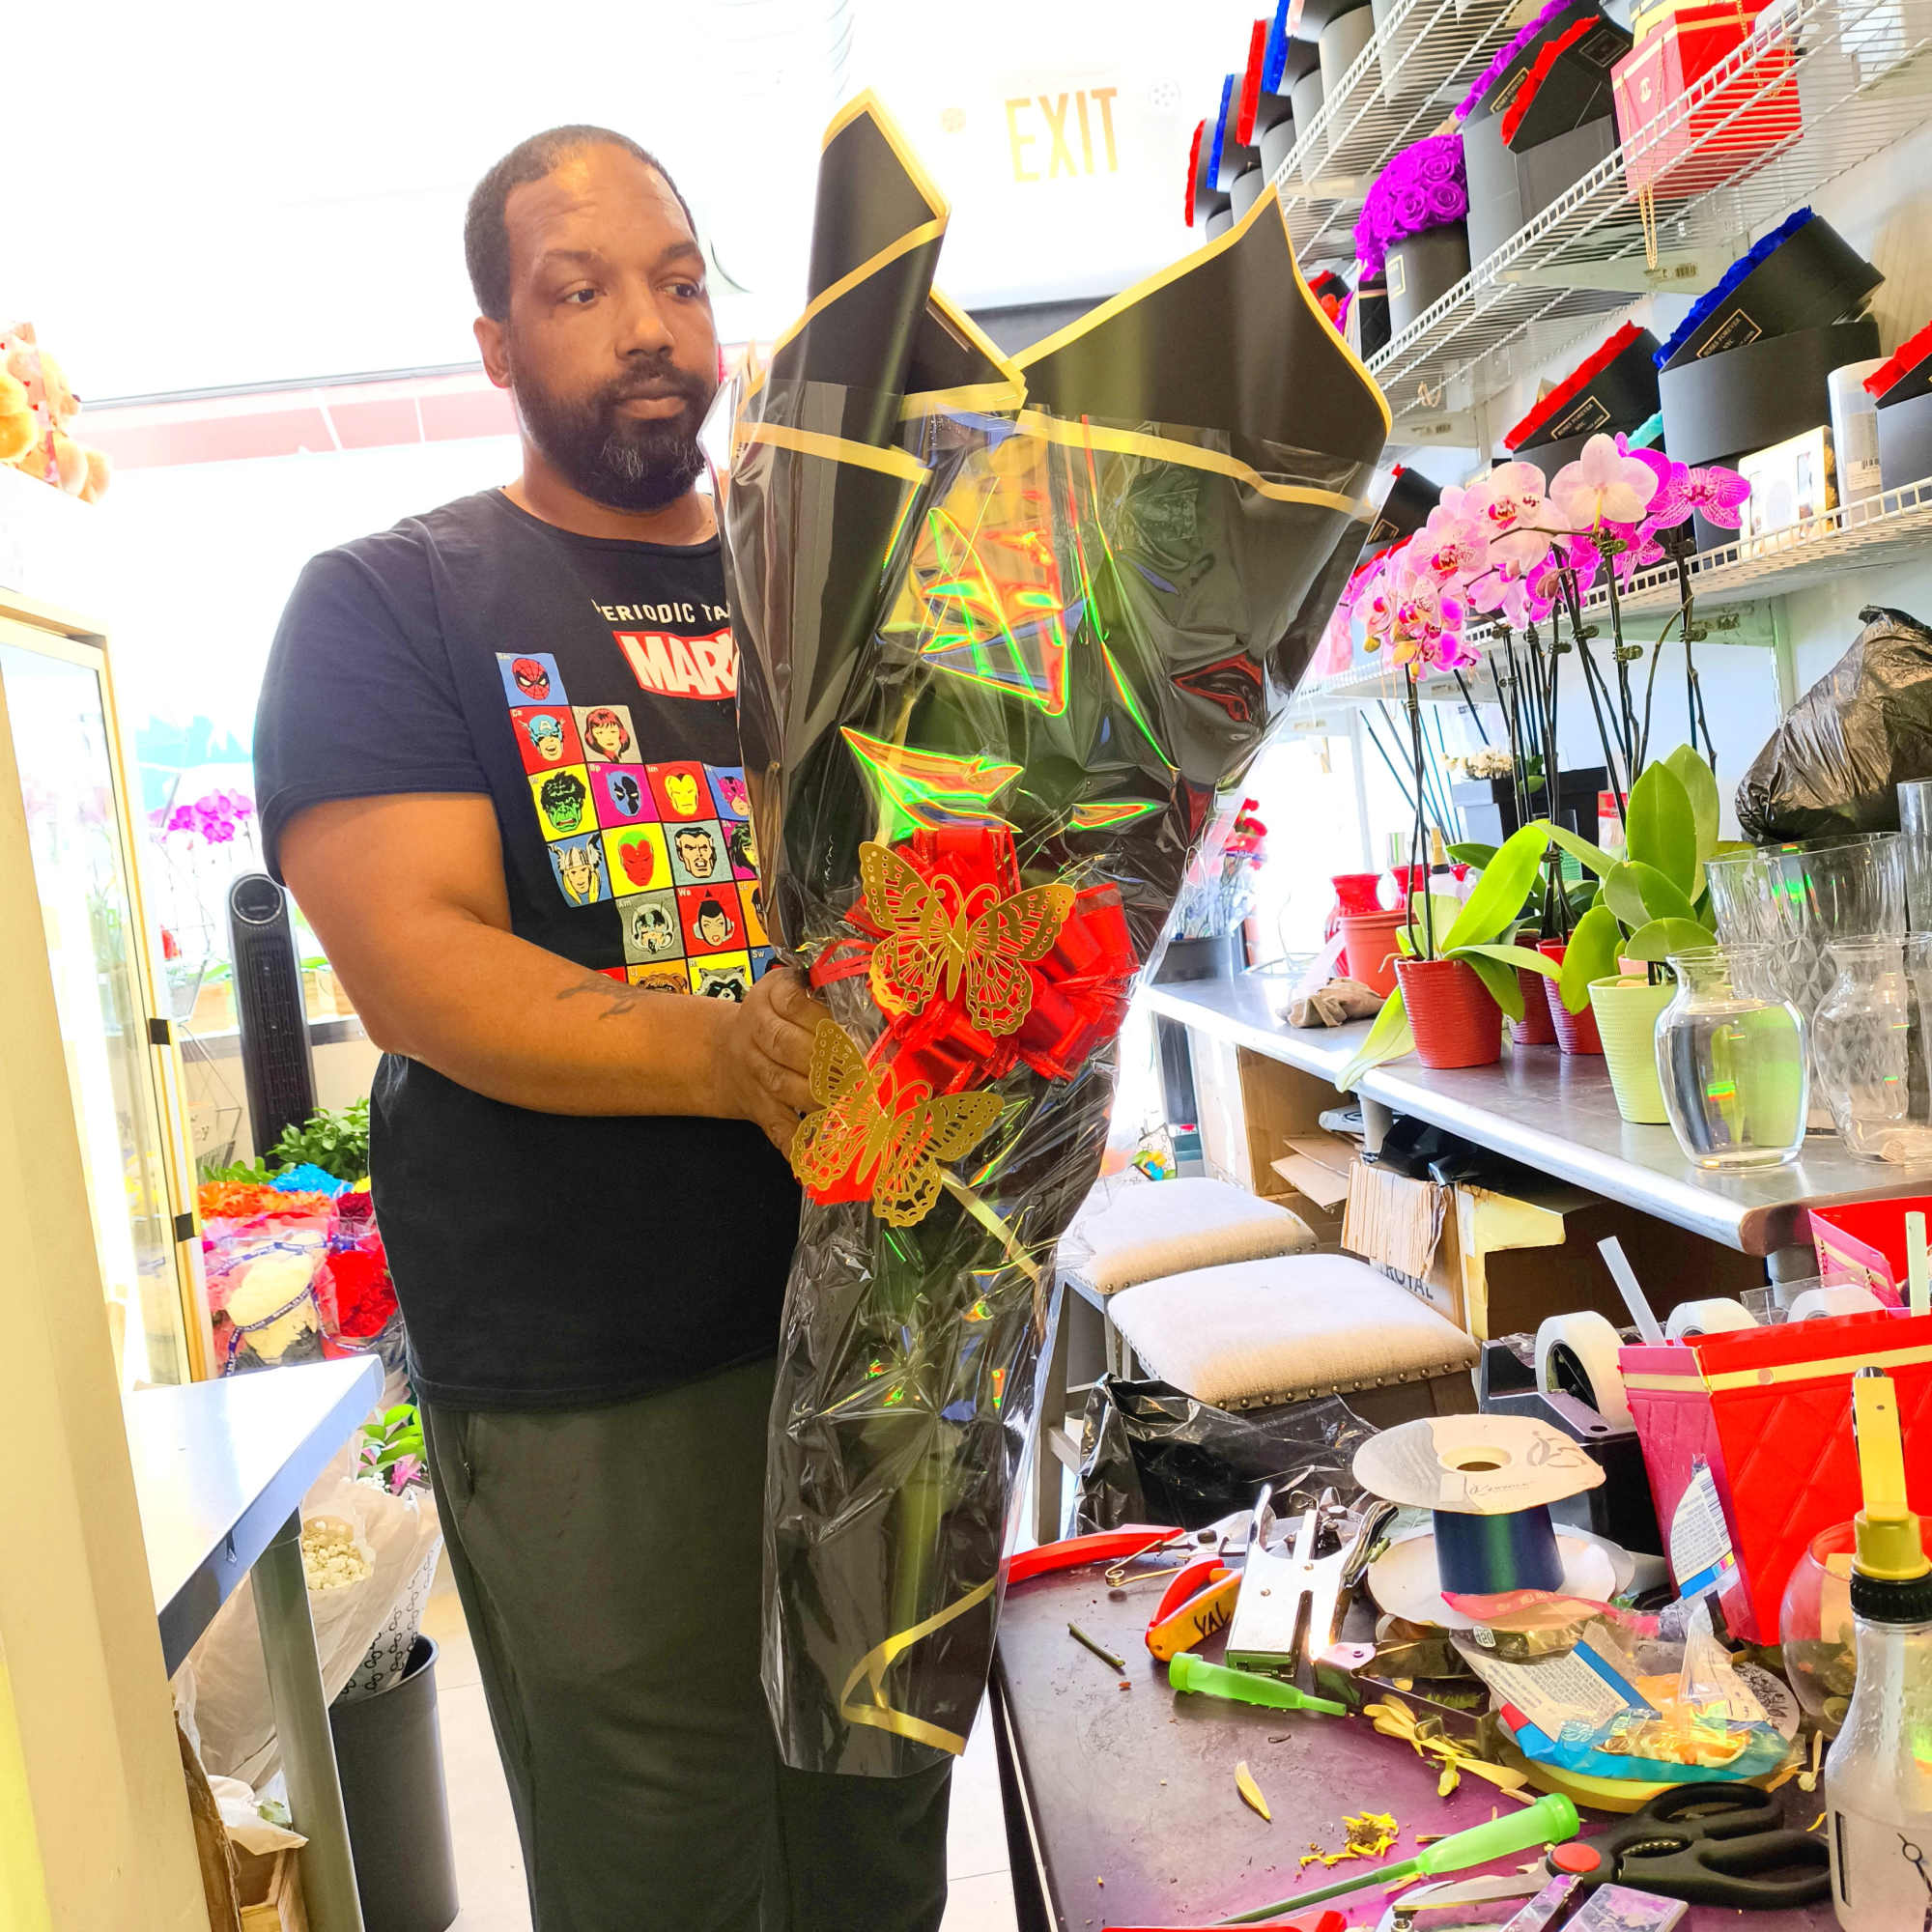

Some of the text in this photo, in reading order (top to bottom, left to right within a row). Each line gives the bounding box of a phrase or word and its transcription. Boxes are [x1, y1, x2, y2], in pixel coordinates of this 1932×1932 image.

[1005, 87, 1118, 183] EXIT
[590, 598, 696, 623] ERIODIC
[752, 950, 765, 958] Sw
